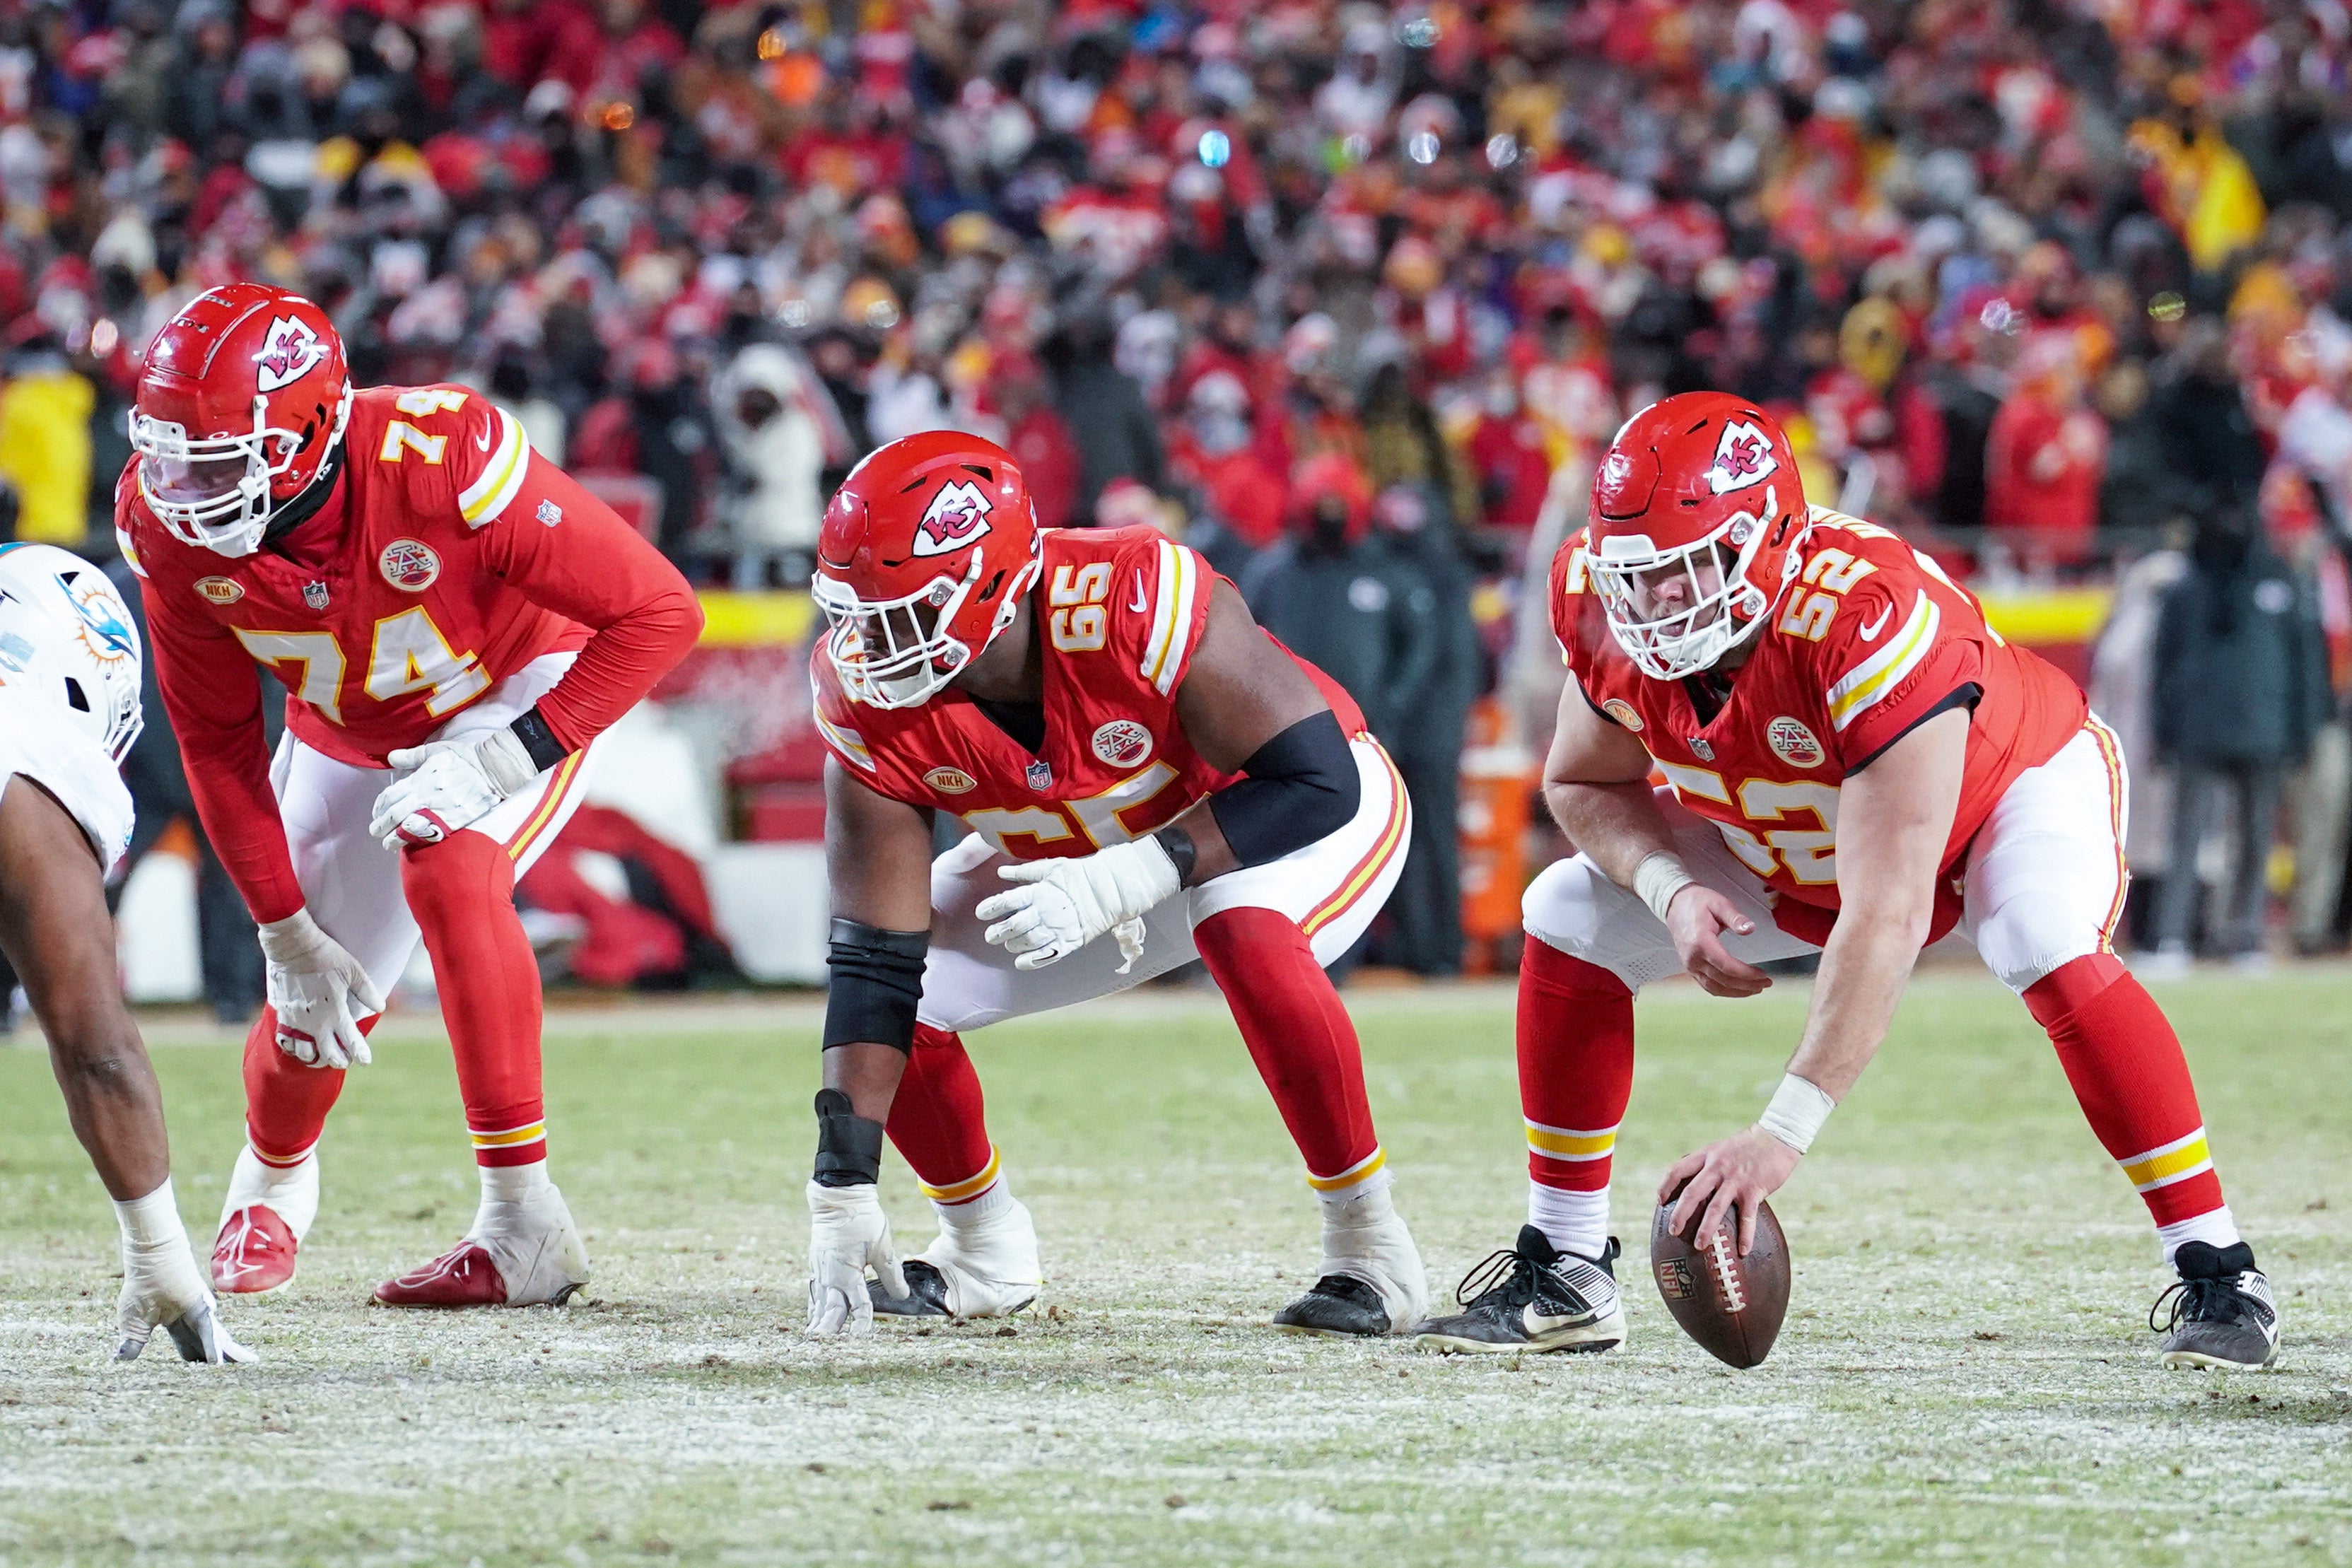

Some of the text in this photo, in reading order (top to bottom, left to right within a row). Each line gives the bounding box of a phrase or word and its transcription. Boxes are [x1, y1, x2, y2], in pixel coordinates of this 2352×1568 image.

[380, 390, 469, 464] 74
[205, 584, 231, 597] NKH
[1049, 561, 1113, 653] 65
[1777, 547, 1878, 643] 52
[229, 604, 493, 727] 74
[936, 774, 964, 787] NKH
[1030, 773, 1049, 786] NFL
[1651, 754, 1841, 884] 52
[1661, 1264, 1680, 1297] NFL
